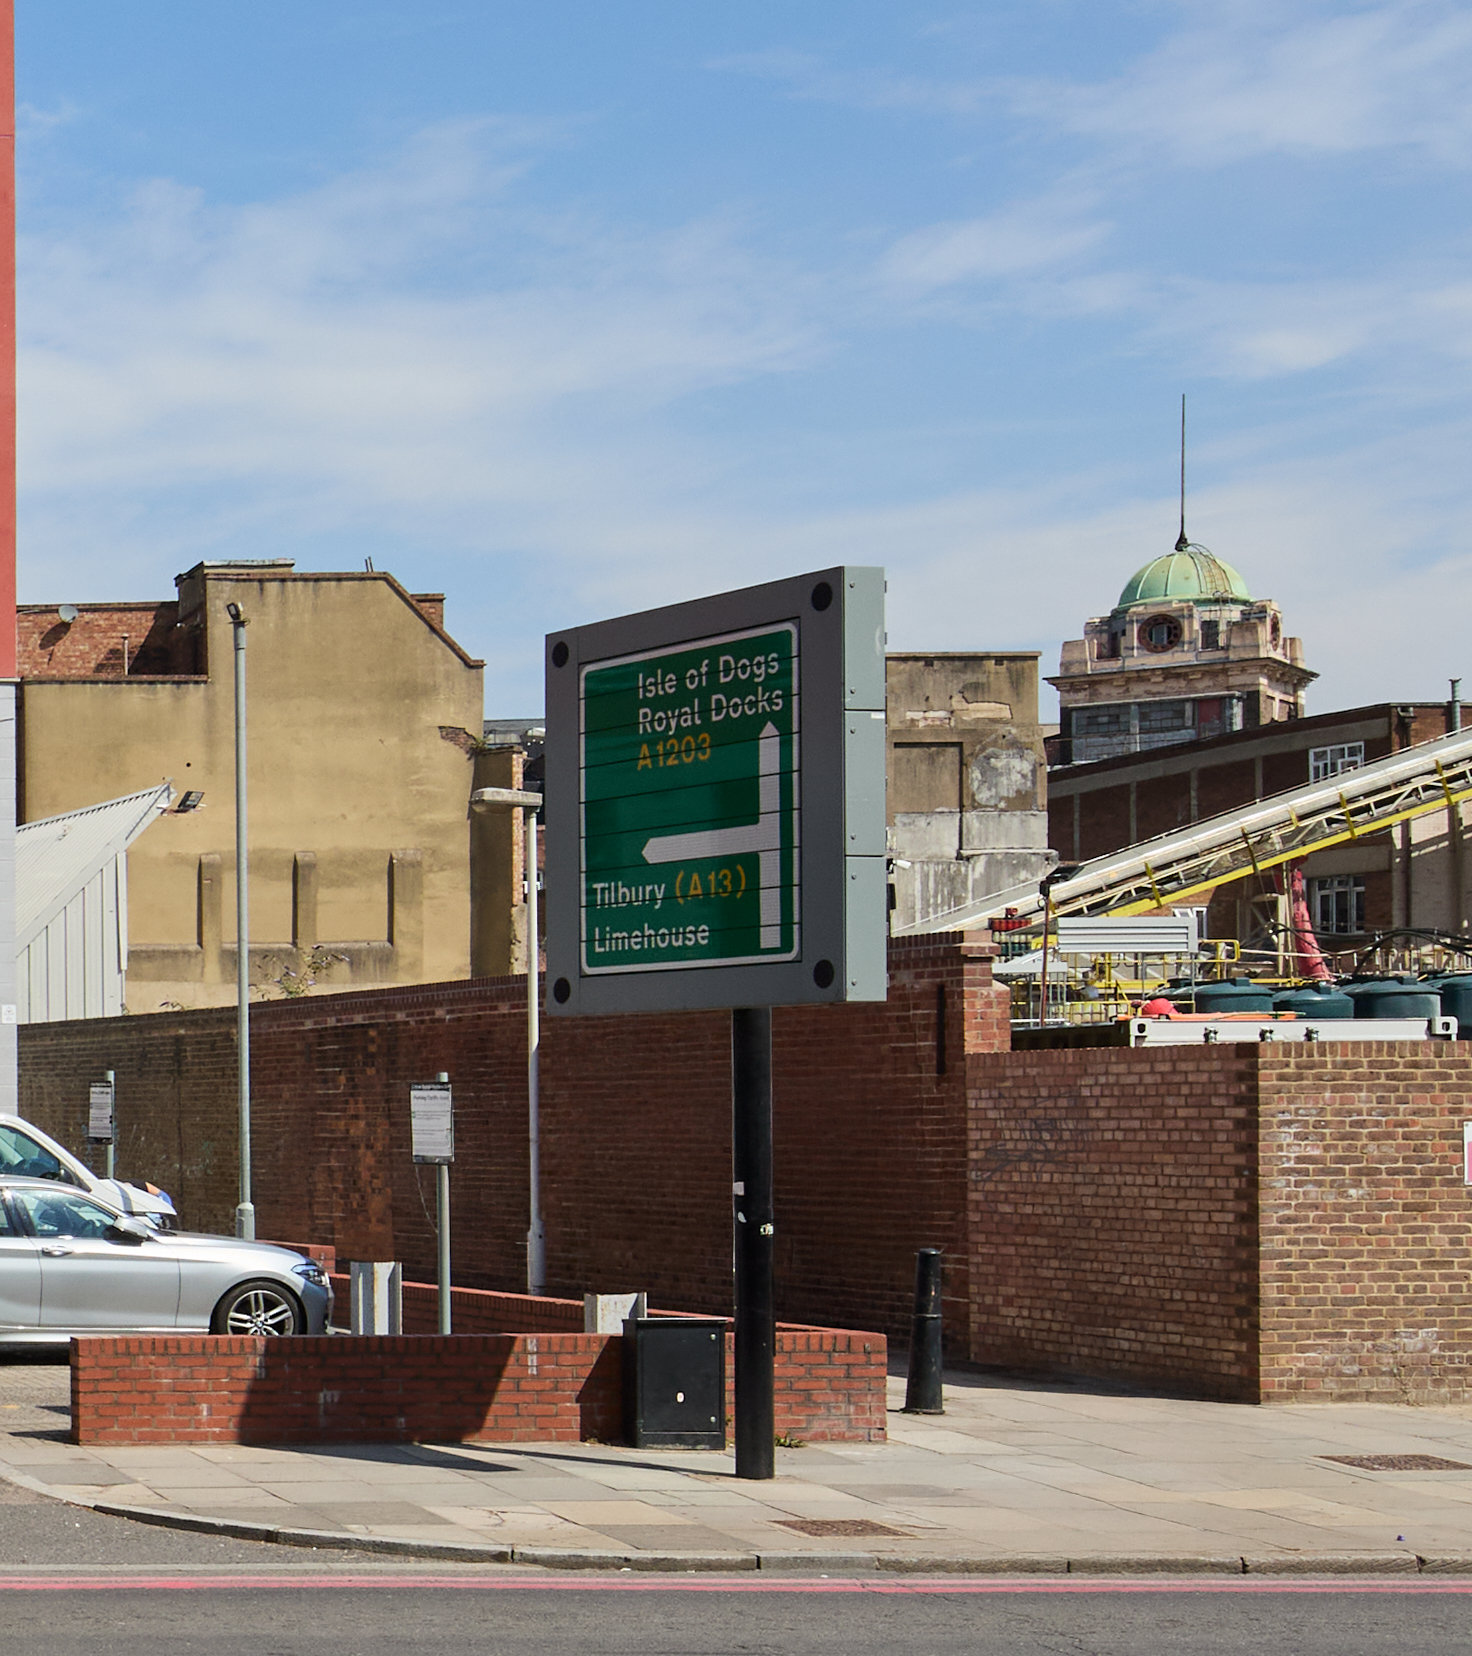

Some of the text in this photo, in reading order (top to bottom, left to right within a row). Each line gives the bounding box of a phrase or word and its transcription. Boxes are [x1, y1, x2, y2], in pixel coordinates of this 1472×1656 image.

[639, 652, 780, 699] Isle of Dogs
[639, 686, 784, 735] Royal Docks
[637, 732, 712, 771] A1203
[592, 863, 746, 910] Tilbury (A13)
[594, 922, 710, 953] Limehouse
